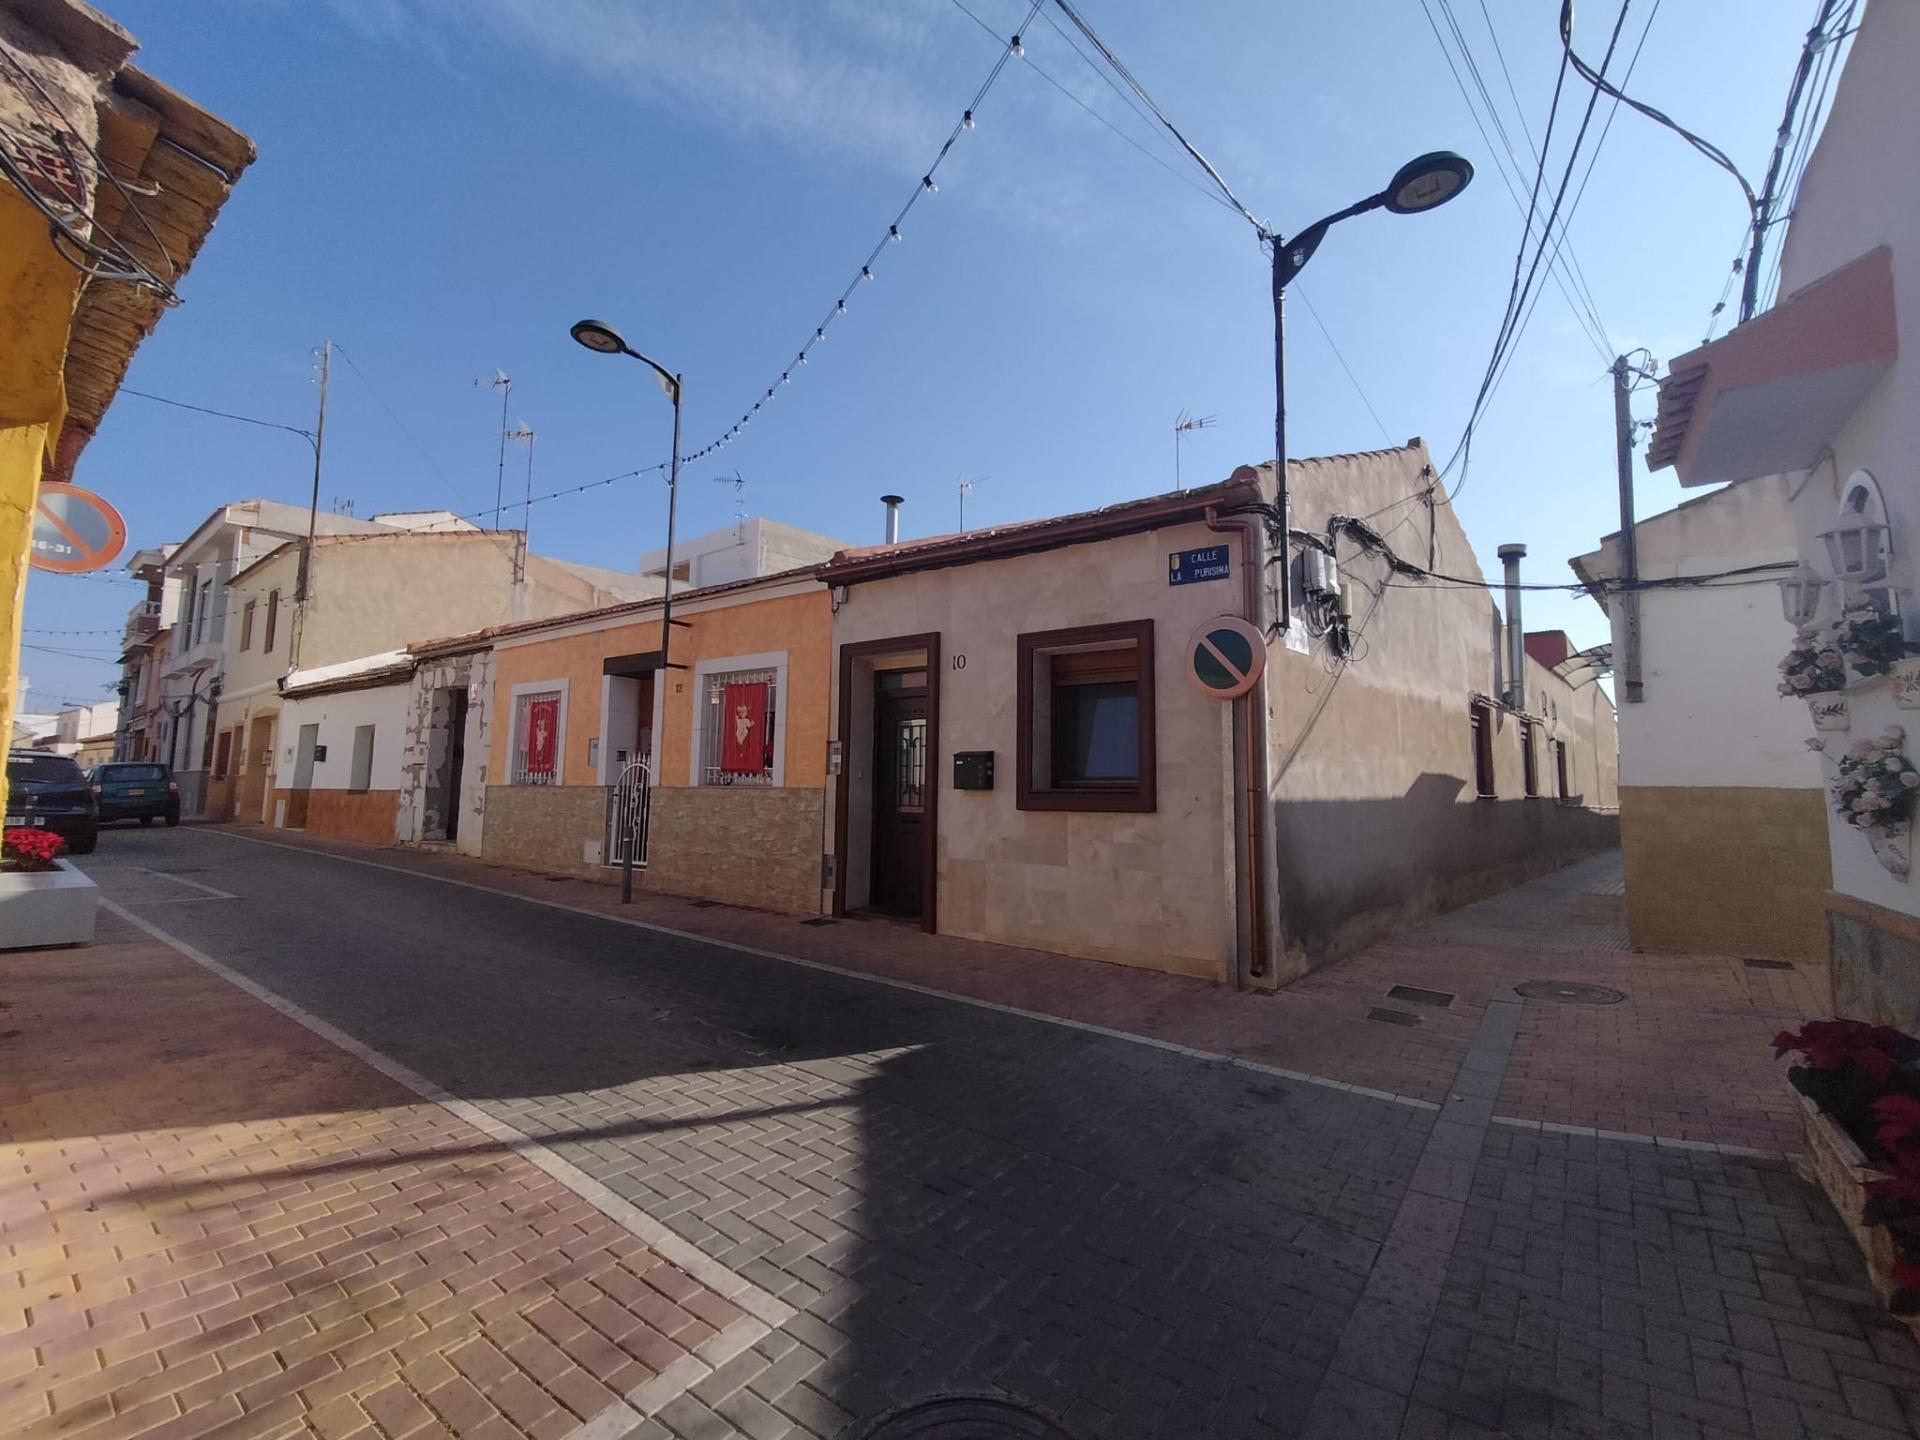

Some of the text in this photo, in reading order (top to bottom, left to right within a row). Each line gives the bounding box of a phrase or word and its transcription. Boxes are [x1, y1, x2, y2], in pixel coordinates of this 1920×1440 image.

[1191, 551, 1217, 563] CALLE
[1171, 564, 1230, 582] LA PURISIMA
[953, 655, 966, 670] 10
[676, 684, 684, 693] 12
